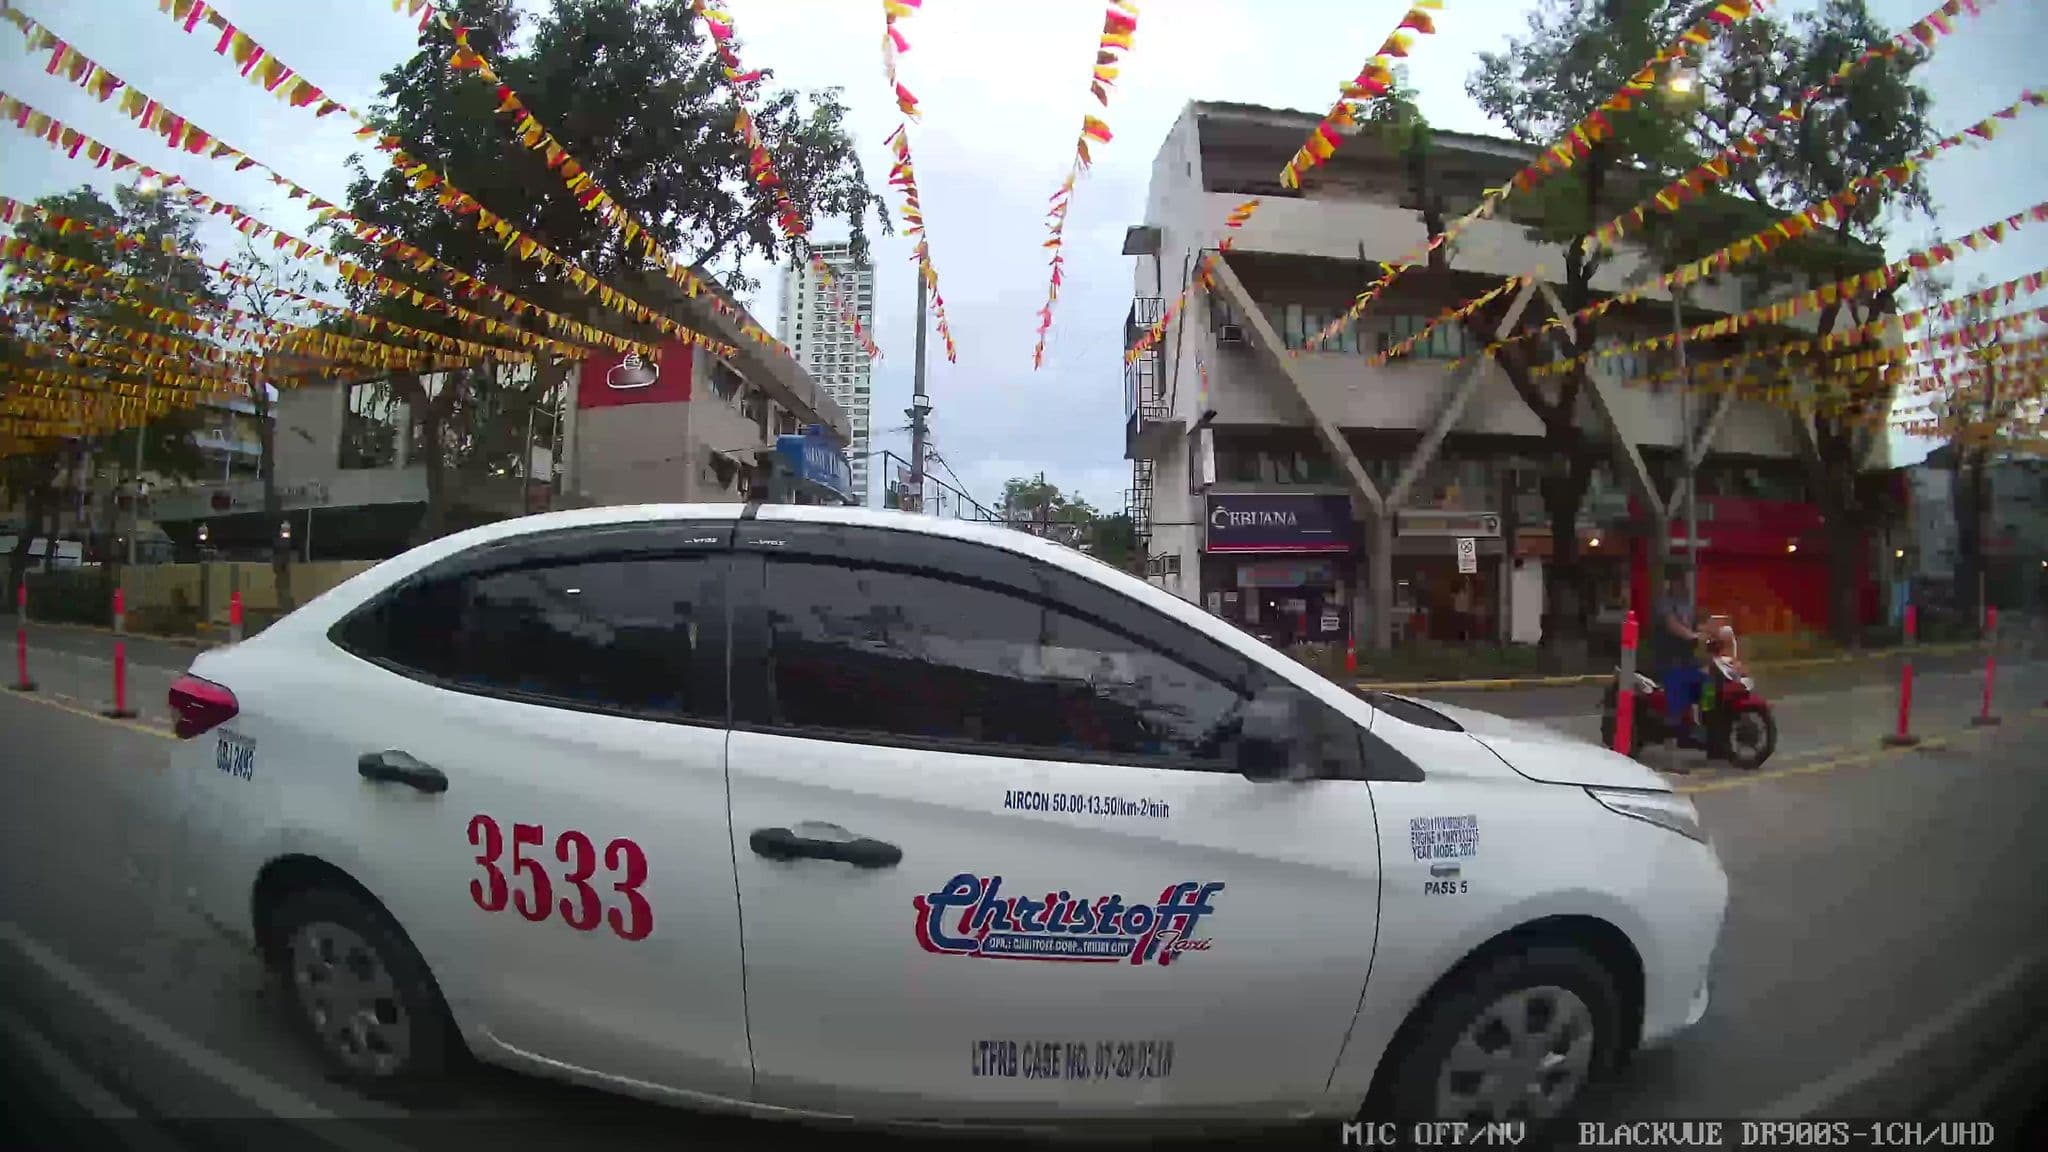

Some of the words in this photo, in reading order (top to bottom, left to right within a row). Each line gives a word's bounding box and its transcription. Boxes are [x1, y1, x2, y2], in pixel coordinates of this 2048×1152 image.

[1004, 789, 1049, 811] AIRCON
[1434, 843, 1458, 858] MODEL
[467, 814, 654, 941] 3533
[1424, 881, 1457, 895] PASS
[1460, 880, 1468, 894] 5
[913, 873, 1225, 965] Christoff
[972, 1040, 1017, 1076] LTFRB
[1022, 1041, 1060, 1079] CASE
